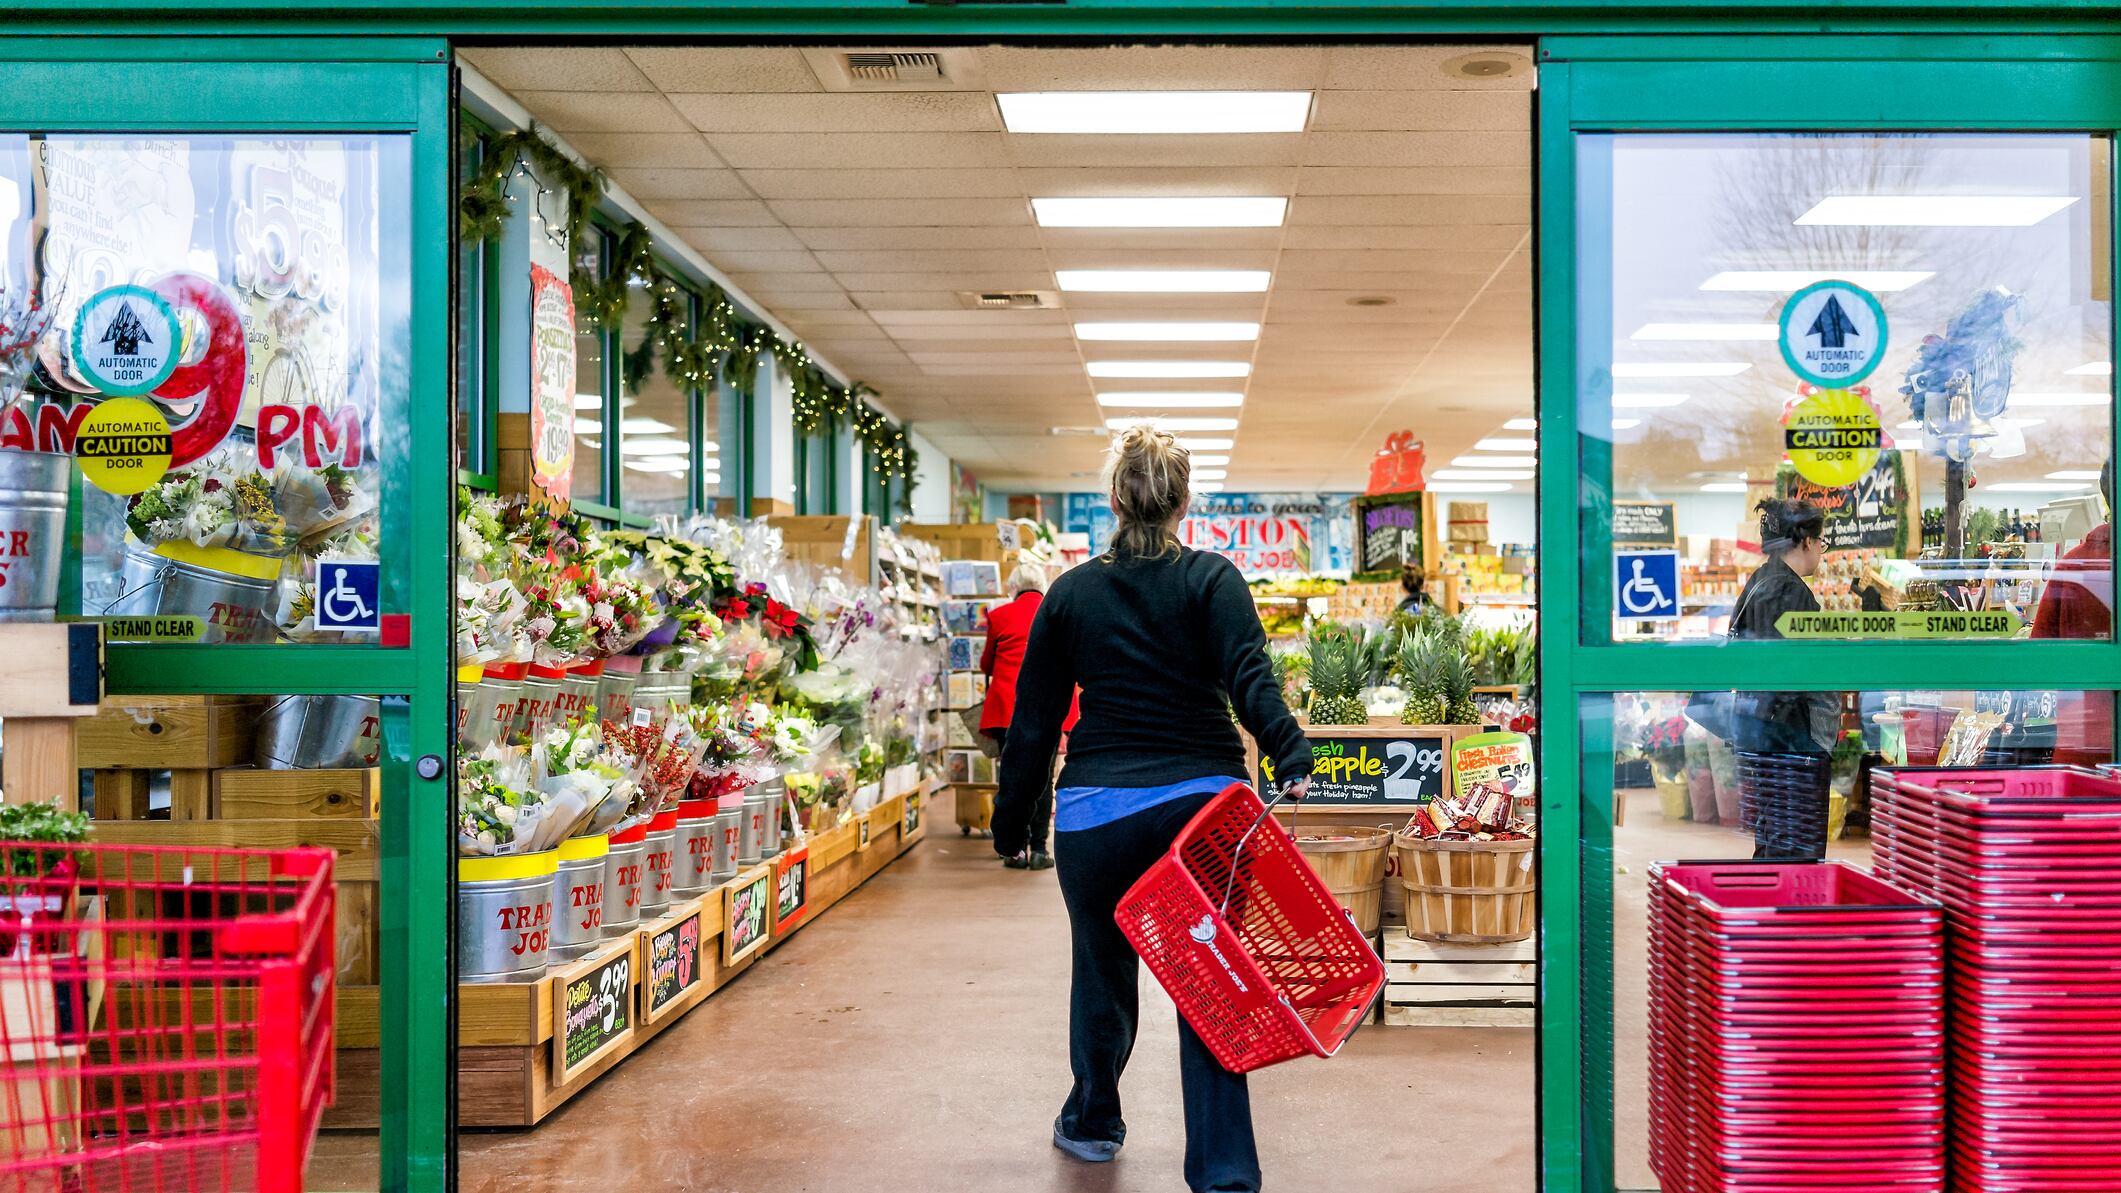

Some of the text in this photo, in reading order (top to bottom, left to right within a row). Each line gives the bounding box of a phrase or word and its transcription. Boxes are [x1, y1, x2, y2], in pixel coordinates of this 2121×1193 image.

[42, 166, 96, 206] VALUE
[1805, 350, 1865, 361] AUTOMATIC
[99, 357, 157, 368] AUTOMATIC
[1820, 362, 1850, 373] DOOR
[114, 370, 143, 380] DOOR
[1797, 415, 1872, 425] AUTOMATIC
[87, 422, 162, 433] AUTOMATIC
[257, 402, 364, 471] PM
[1792, 430, 1877, 447] CAUTION
[82, 437, 167, 454] CAUTION
[1816, 451, 1853, 461] DOOR
[106, 459, 143, 469] DOOR
[112, 620, 194, 636] STAND CLEAR
[1789, 616, 2009, 632] AUTOMATIC DOOR STAND CLEAR
[1322, 781, 1342, 789] fresh
[1344, 783, 1378, 793] pineapple
[1306, 790, 1322, 799] your
[1323, 790, 1349, 800] Holiday
